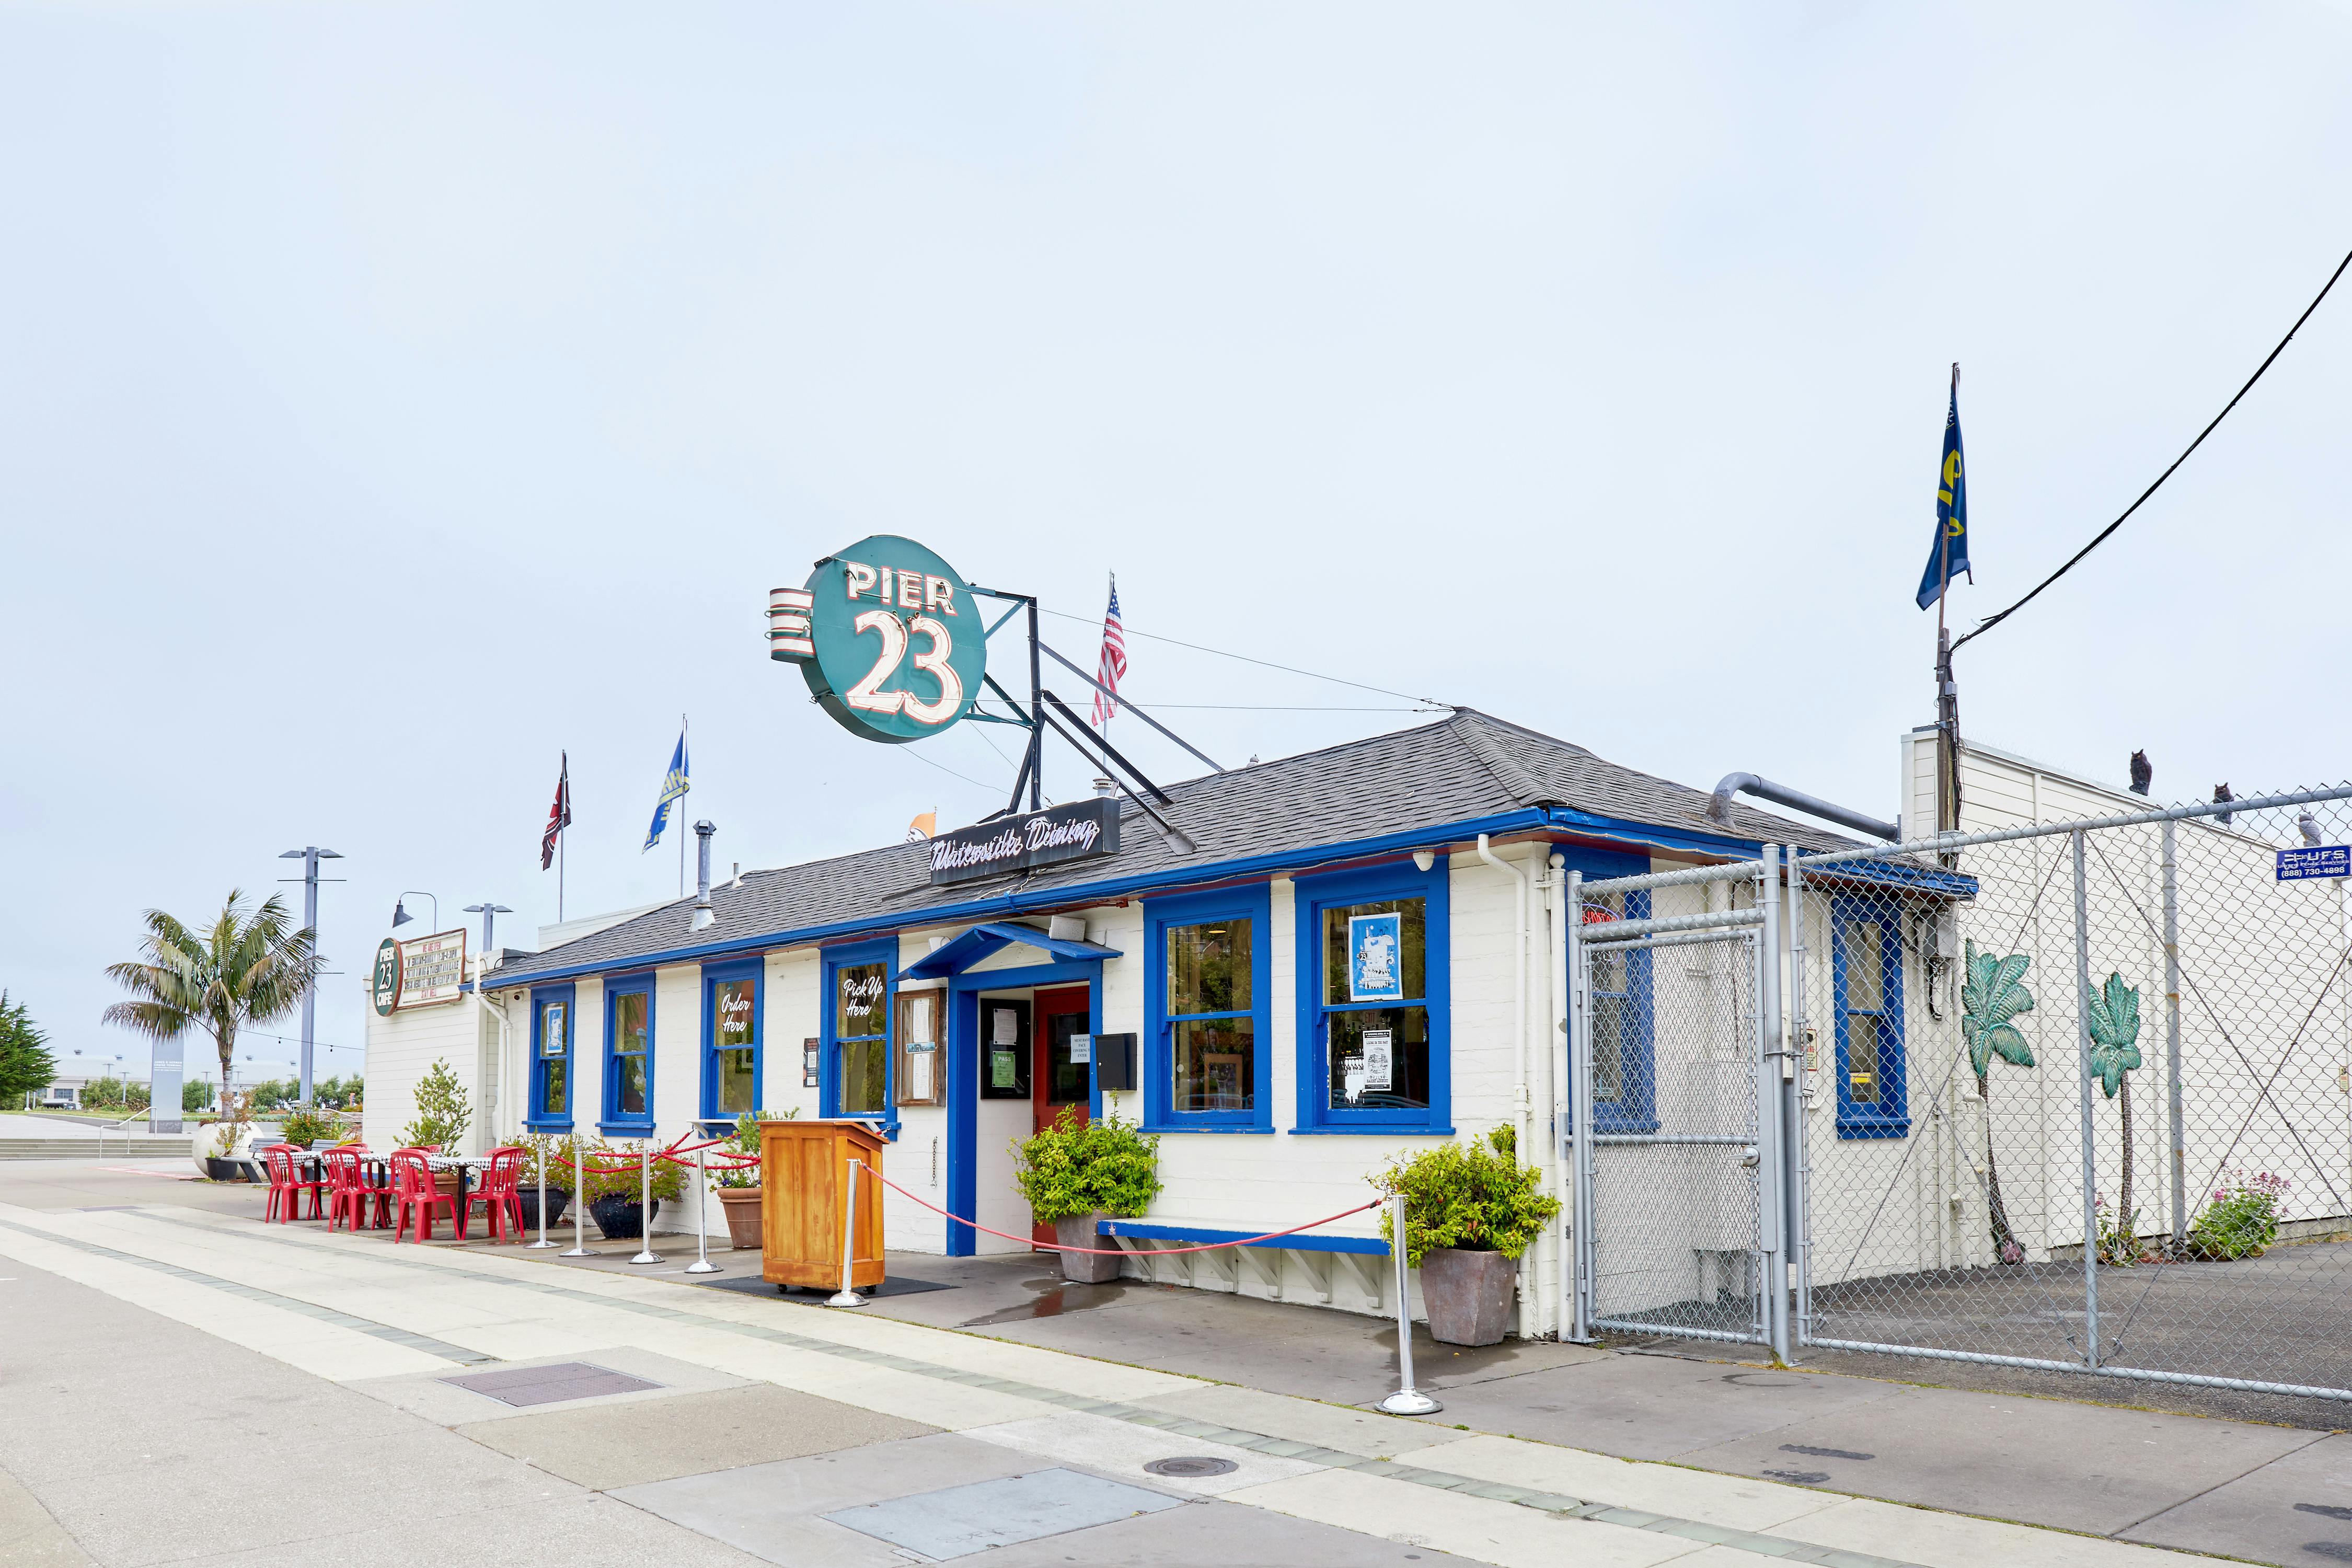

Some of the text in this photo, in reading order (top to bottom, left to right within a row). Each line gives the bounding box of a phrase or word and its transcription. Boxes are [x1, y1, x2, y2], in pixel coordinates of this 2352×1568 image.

[846, 561, 958, 616] PIER
[845, 609, 963, 725] 23
[1025, 816, 1100, 851] Dining
[2281, 867, 2345, 878] (888) 730-4898
[379, 947, 395, 963] PIER
[378, 962, 393, 990] 23
[377, 991, 393, 1007] CAFE
[843, 975, 883, 1003] Pick Up
[721, 993, 751, 1014] Order
[846, 998, 872, 1017] Here
[723, 1013, 747, 1033] Here
